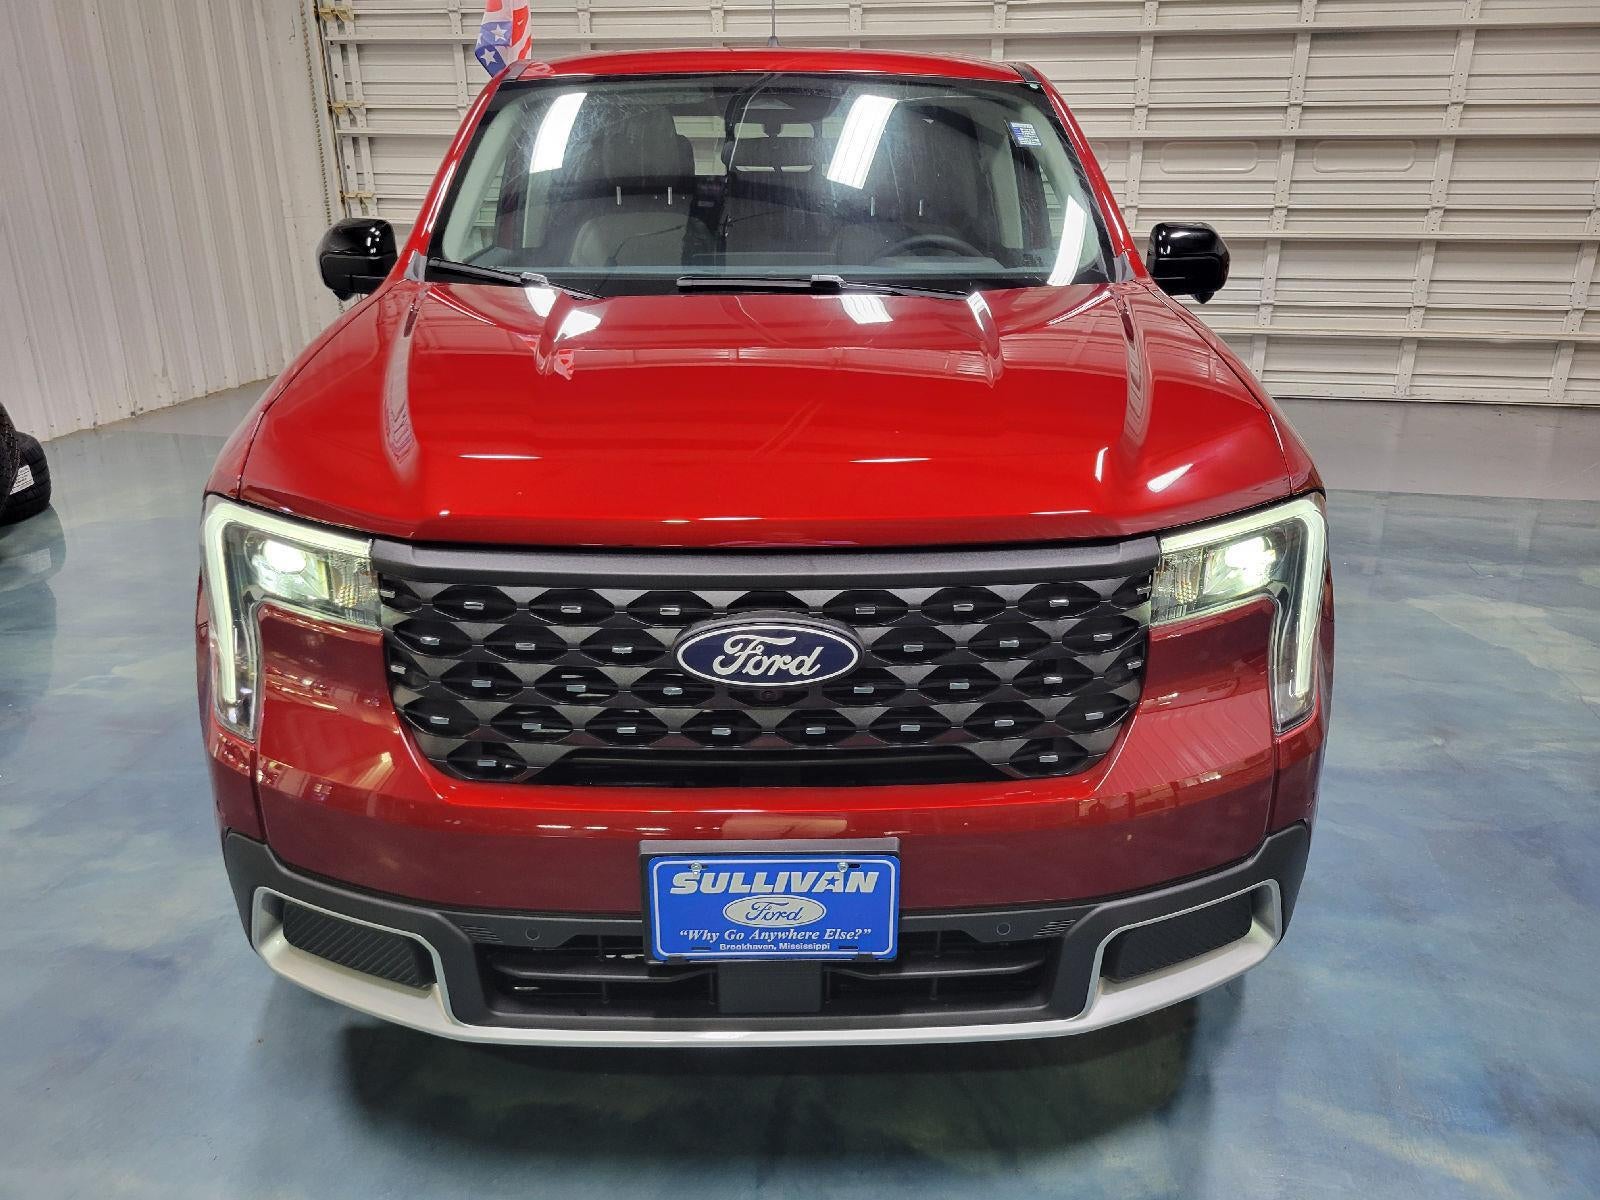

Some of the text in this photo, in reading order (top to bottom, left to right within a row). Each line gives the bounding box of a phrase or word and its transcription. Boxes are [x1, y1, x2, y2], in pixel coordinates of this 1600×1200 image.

[713, 634, 825, 676] Ford
[669, 871, 880, 895] SULLIVAN
[745, 902, 804, 921] Ford
[724, 929, 745, 941] Go
[749, 928, 820, 942] Anywhere
[719, 942, 831, 951] Brookhaven, Mississippi
